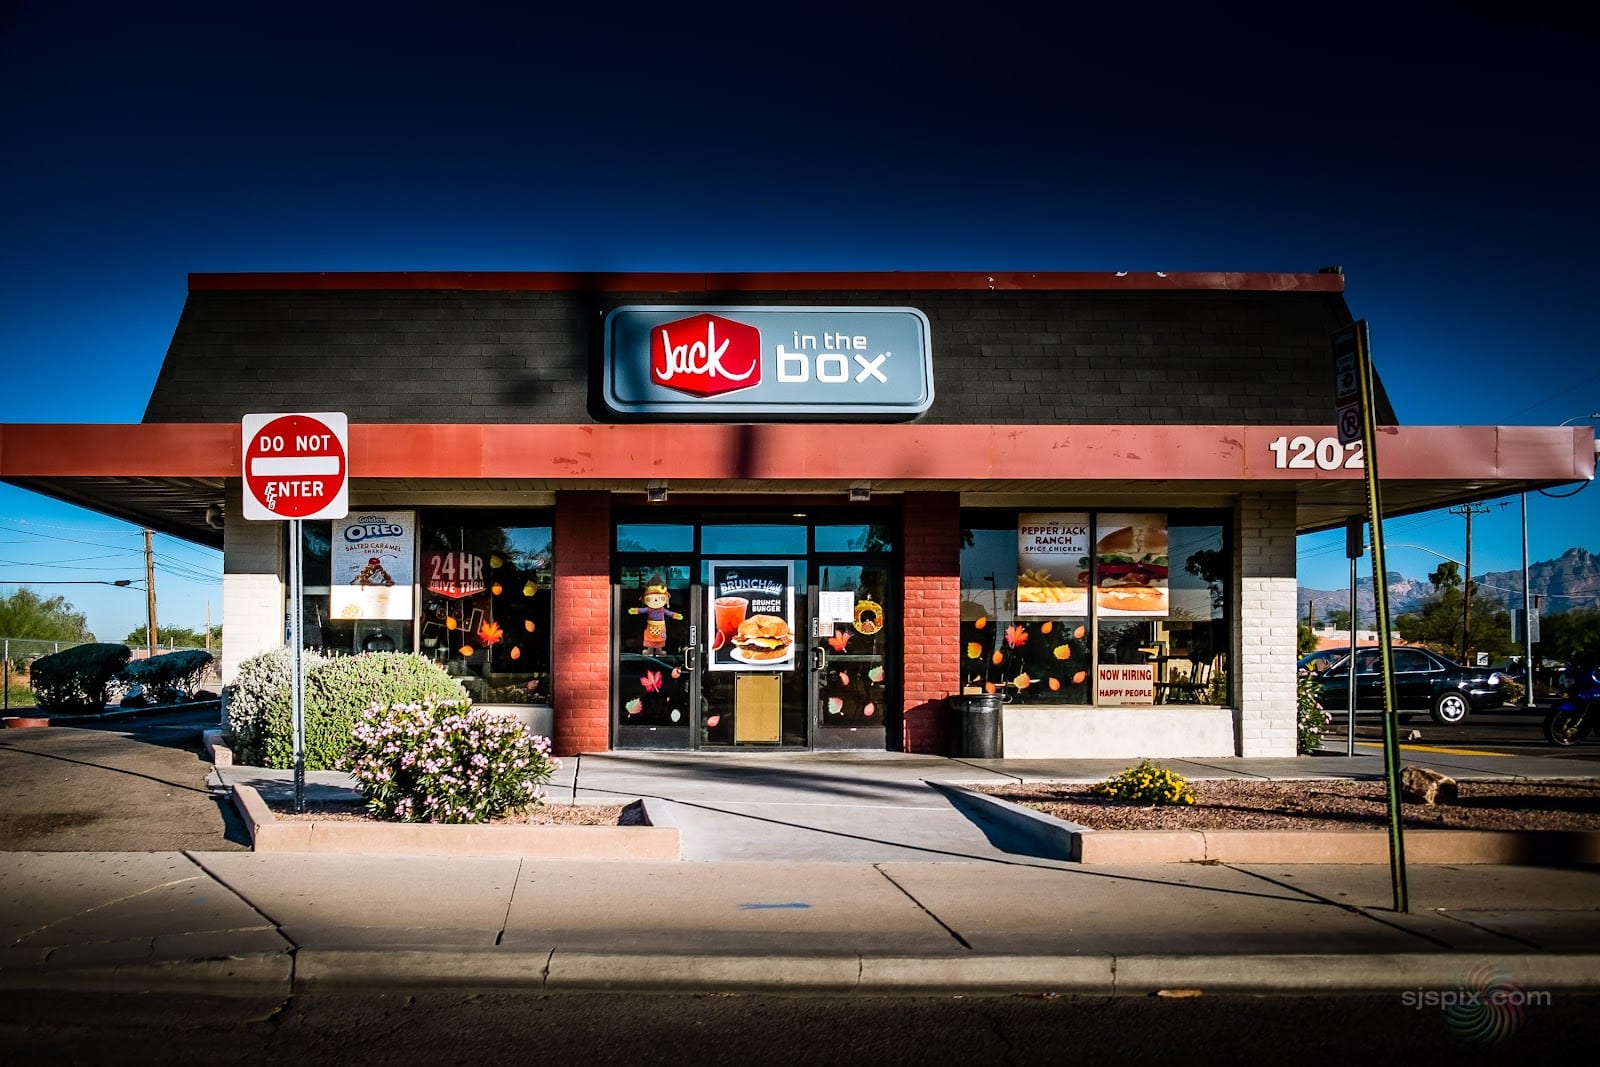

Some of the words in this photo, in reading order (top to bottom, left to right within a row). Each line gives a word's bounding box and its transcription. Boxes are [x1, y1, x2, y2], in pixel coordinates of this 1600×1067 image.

[793, 330, 817, 350] in
[823, 331, 867, 350] the
[656, 321, 756, 381] Jack
[776, 344, 889, 383] box
[260, 435, 285, 452] DO
[296, 434, 331, 451] NOT
[1269, 435, 1365, 470] 1202
[266, 480, 324, 497] ENTER
[359, 514, 386, 524] Golden
[344, 524, 403, 542] OREO
[1021, 526, 1059, 535] PEPPER
[1060, 526, 1087, 535] JACK
[345, 542, 369, 552] SALTED
[370, 542, 402, 552] CARAMEL
[1035, 536, 1072, 545] RANCH
[431, 552, 456, 580] 24
[459, 552, 484, 580] HR
[430, 580, 455, 593] DRIVE
[460, 580, 485, 593] THRU
[751, 605, 782, 613] BURGER
[1099, 669, 1120, 681] NOW
[1122, 669, 1152, 681] HIRING
[1099, 689, 1123, 697] HAPPY
[1124, 689, 1152, 697] PEOPLE
